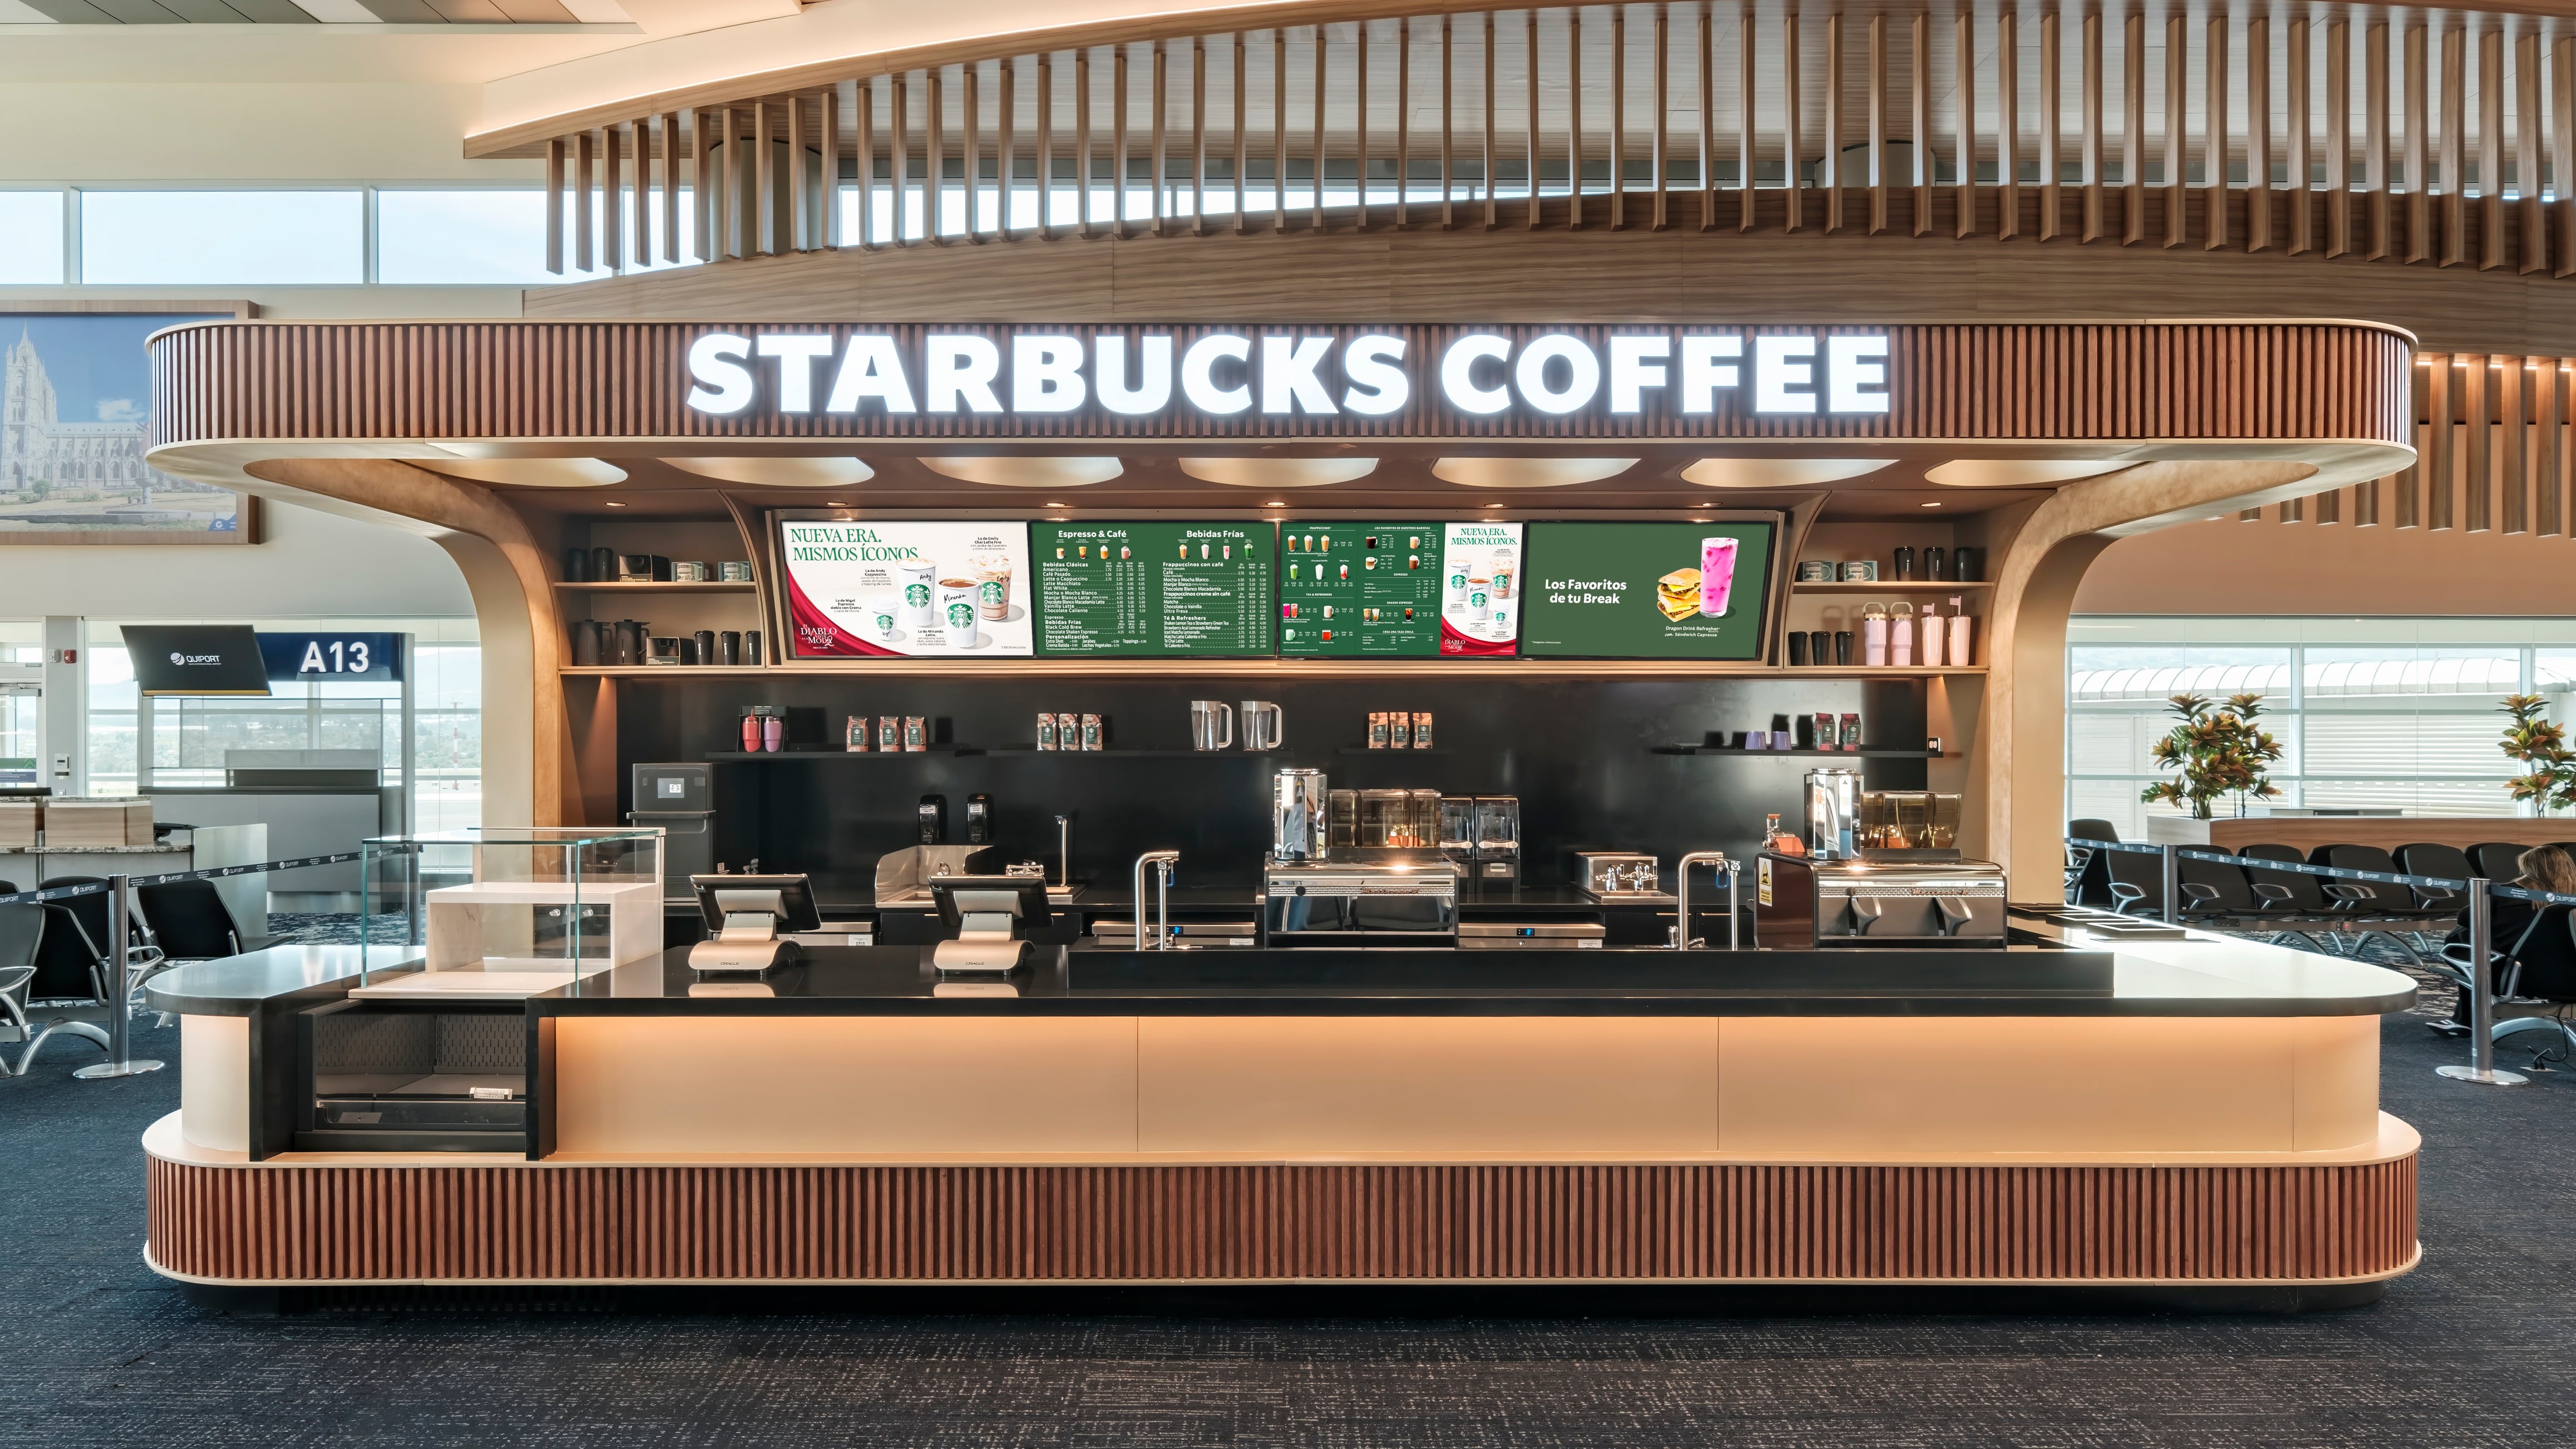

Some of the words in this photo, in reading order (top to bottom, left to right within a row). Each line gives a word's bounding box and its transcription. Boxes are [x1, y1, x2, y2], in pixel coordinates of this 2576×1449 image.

[687, 333, 1409, 414] STARBUCKS
[1442, 335, 1889, 414] COFFEE
[790, 529, 843, 542] NUEVA
[846, 529, 881, 542] ERA.
[1059, 530, 1096, 539] Espresso
[1486, 536, 1517, 545] ÍCONOS.
[793, 547, 858, 561] MISMOS
[861, 543, 918, 561] ÍCONOS
[1545, 579, 1566, 590] Los
[1568, 579, 1627, 590] Favoritos
[944, 594, 967, 603] Miranda
[1550, 592, 1566, 603] de
[1567, 594, 1581, 603] tu
[1584, 593, 1620, 604] Break
[801, 628, 837, 636] DIABLO
[300, 641, 369, 673] A13
